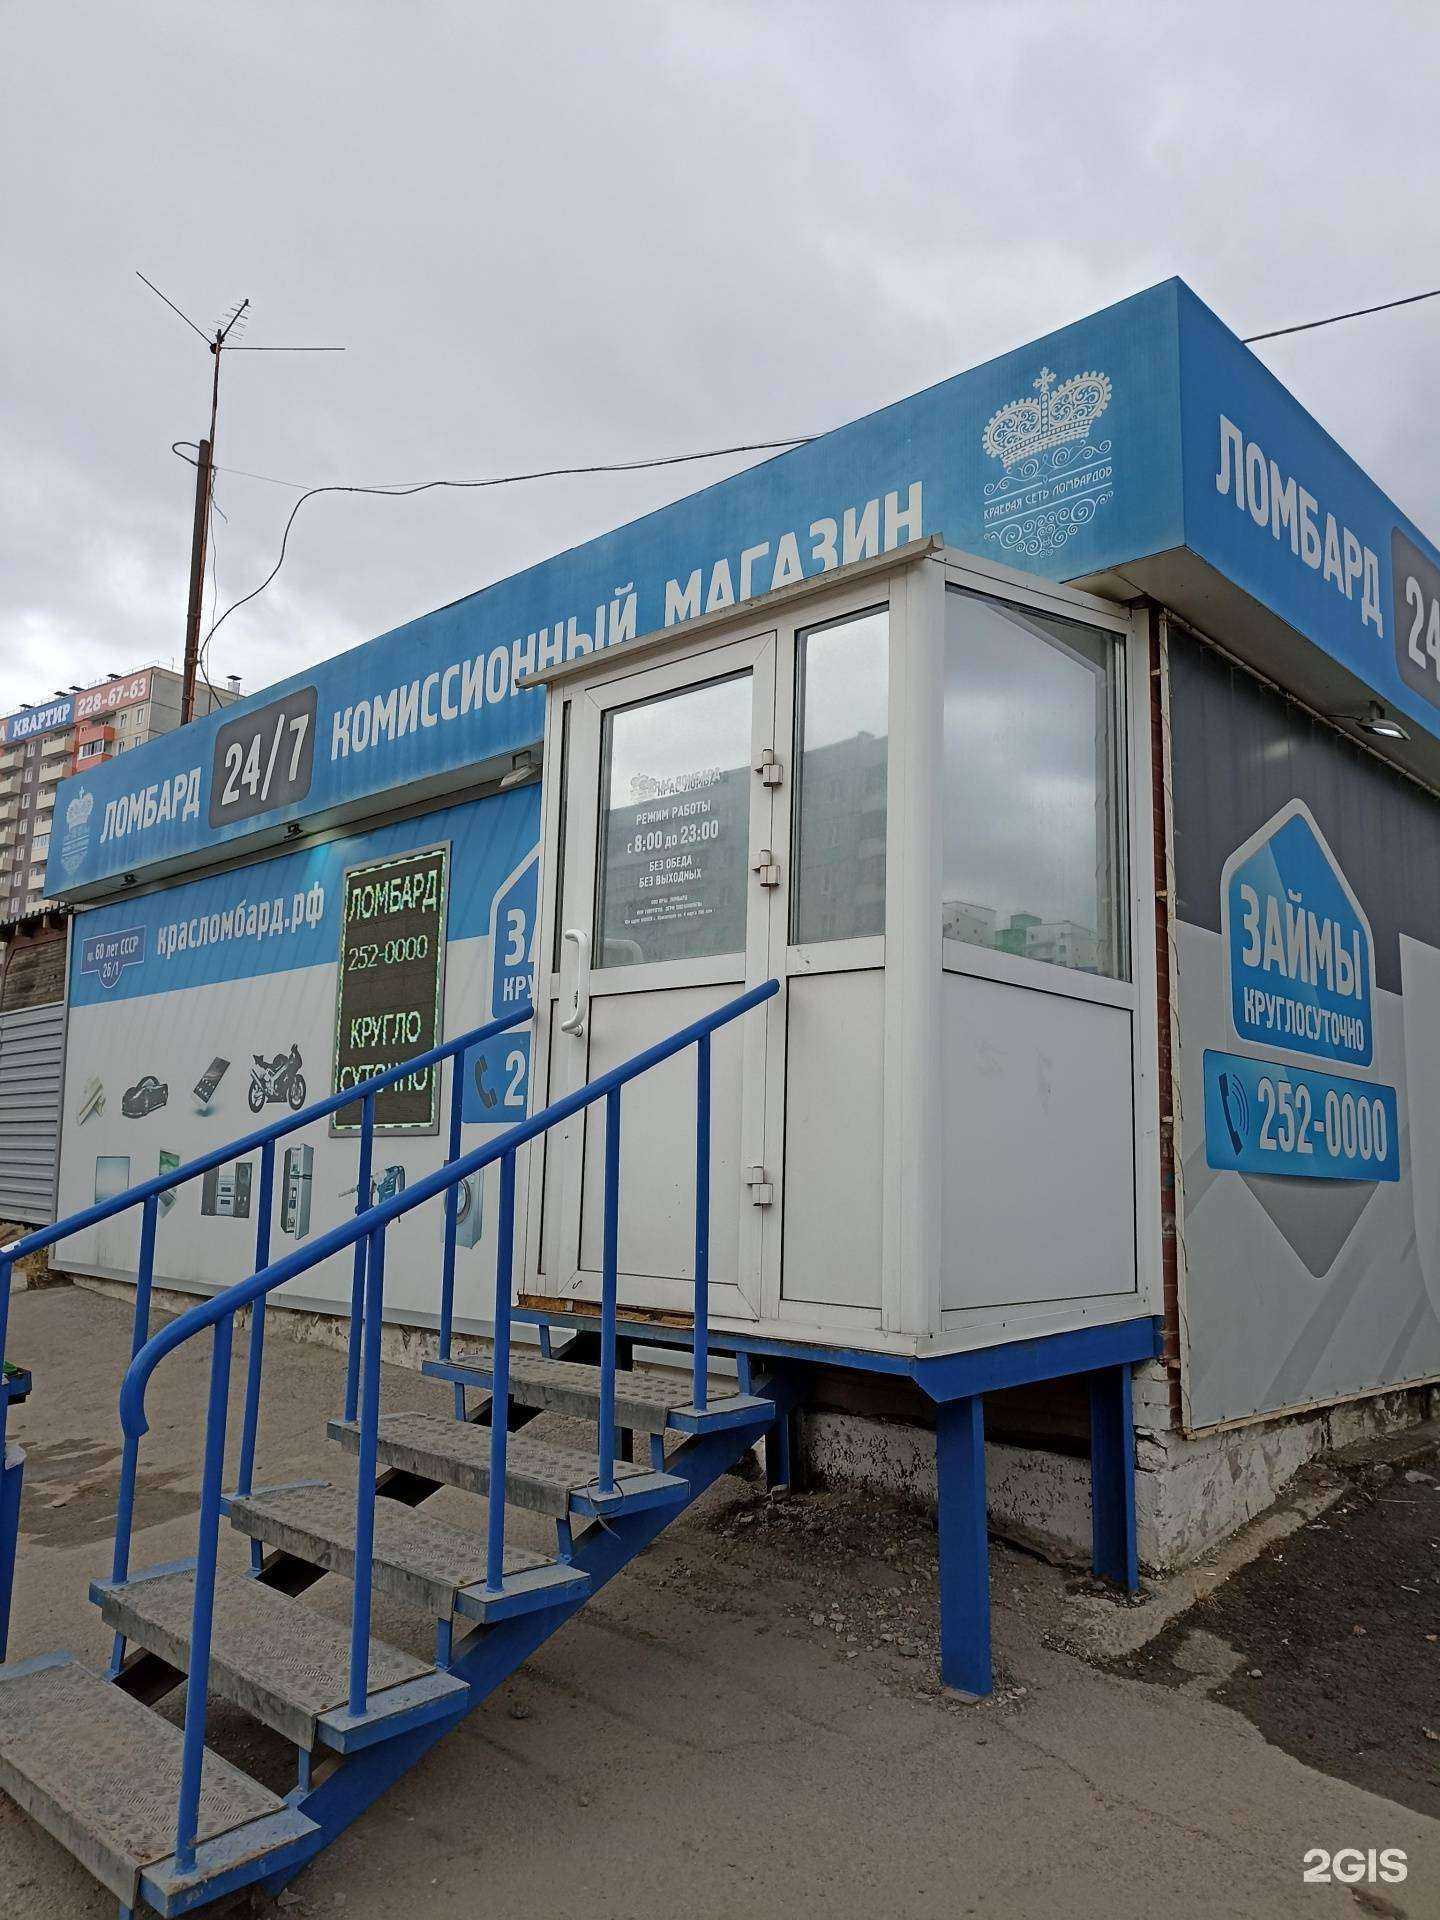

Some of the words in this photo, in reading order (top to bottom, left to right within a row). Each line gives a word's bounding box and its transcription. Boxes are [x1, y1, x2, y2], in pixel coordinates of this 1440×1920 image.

[1216, 413, 1384, 639] ЛОМБАРД
[100, 766, 202, 844] ЛОМБАРД
[221, 713, 309, 806] 24/7
[330, 582, 637, 761] КОМИССИОННЫЙ
[663, 481, 923, 627] МАГАЗИН
[13, 703, 71, 738] КВАРТИР
[77, 677, 147, 717] 228-67-63
[635, 831, 663, 852] 8:00
[664, 834, 677, 849] до
[680, 819, 719, 844] 23:00
[636, 808, 669, 825] РЕЖИМ
[672, 800, 711, 818] РАБОТЫ
[639, 876, 654, 888] БЕЗ
[655, 867, 703, 886] ВЫХОДНЫХ
[649, 859, 664, 872] БЕЗ
[666, 854, 693, 869] ОБЕДА
[157, 881, 325, 959] красломбард.рф
[349, 868, 438, 922] ЛОМБАРД
[95, 942, 105, 960] 60
[105, 943, 119, 958] лет
[120, 935, 139, 955] СССР
[348, 934, 429, 971] 252-0000
[1240, 883, 1363, 1000] ЗАЙМЫ
[350, 1010, 422, 1049] КРУГЛО
[1243, 986, 1365, 1052] КРУГЛОСУТОЧНО
[1256, 1075, 1388, 1162] 252-0000
